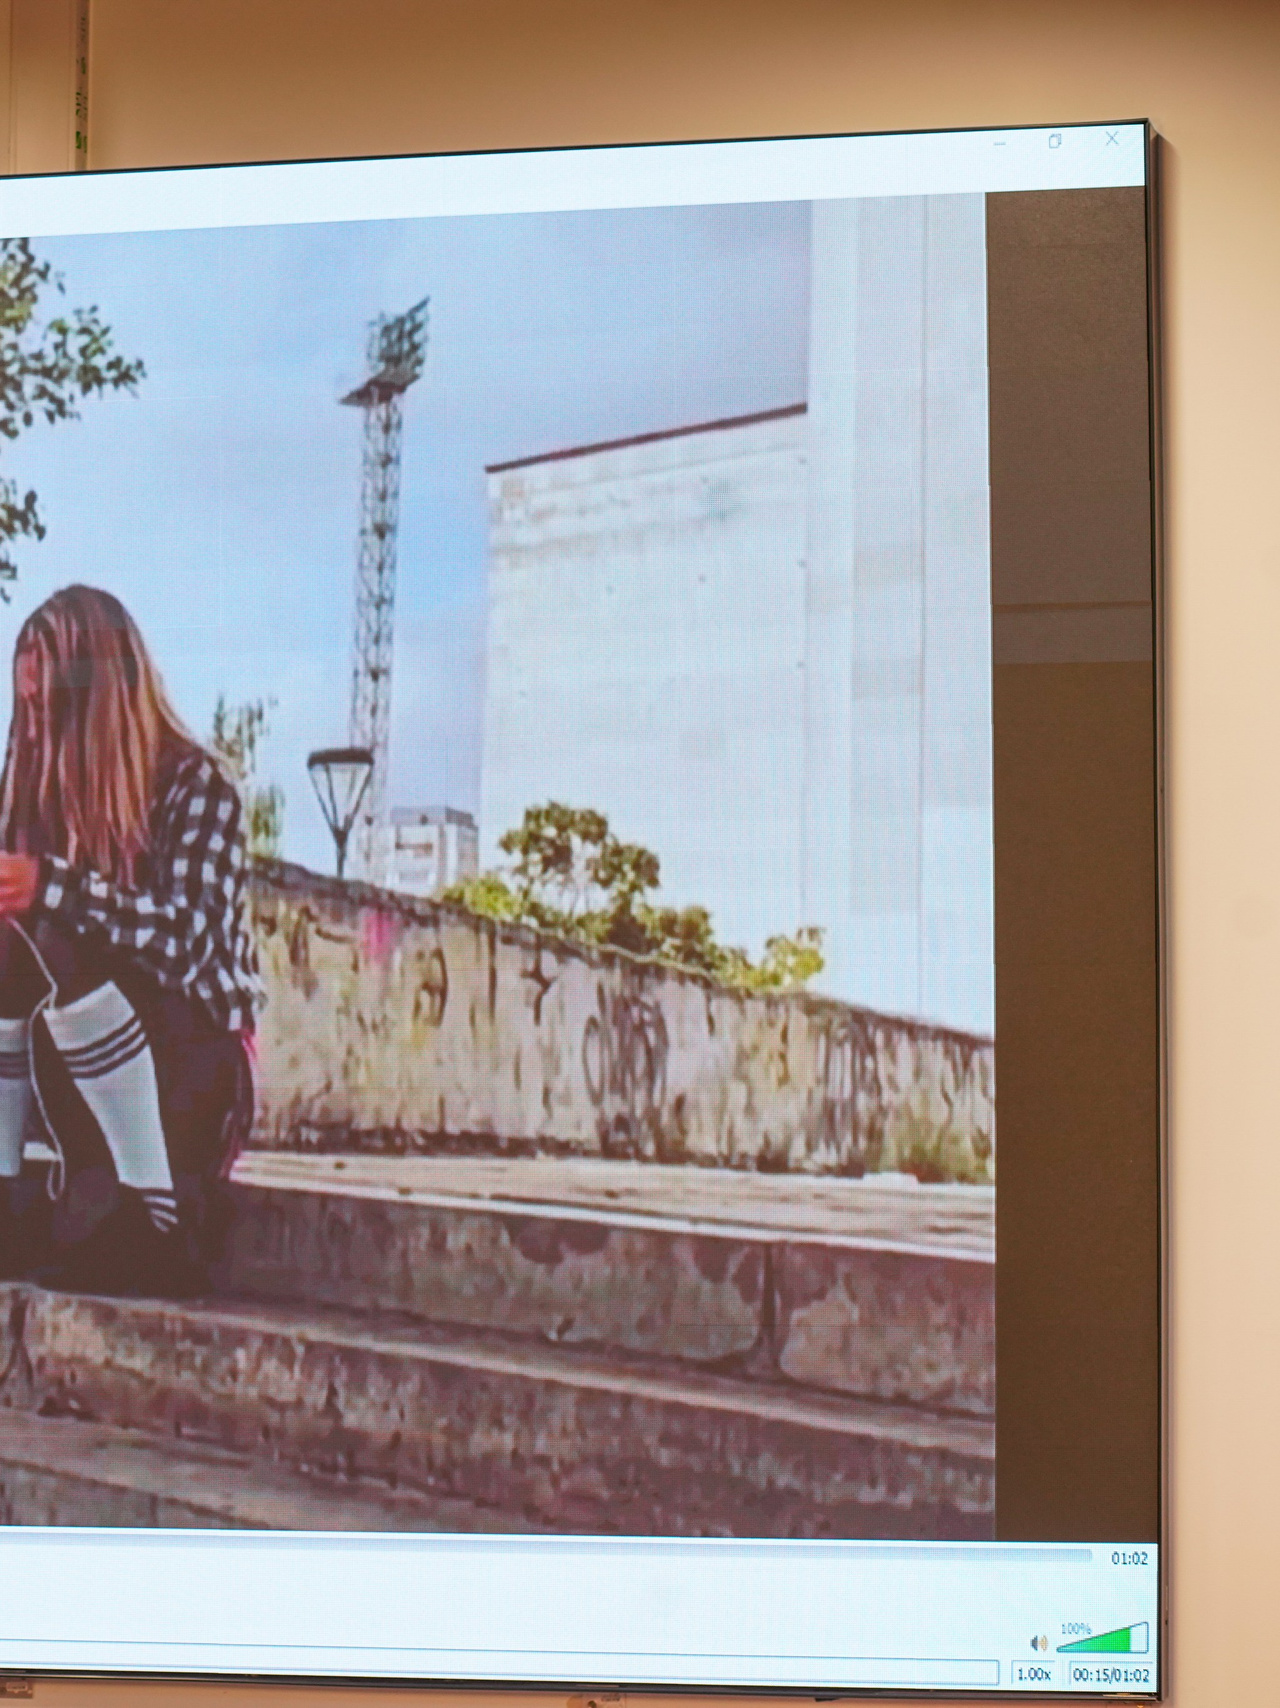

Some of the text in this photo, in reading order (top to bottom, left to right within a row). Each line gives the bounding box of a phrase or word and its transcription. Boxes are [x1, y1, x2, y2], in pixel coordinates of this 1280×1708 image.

[1112, 1552, 1148, 1565] 01:02
[1061, 1623, 1092, 1634] 100%
[1018, 1668, 1051, 1681] 1.00x
[1073, 1668, 1150, 1684] 00:15/01:02
